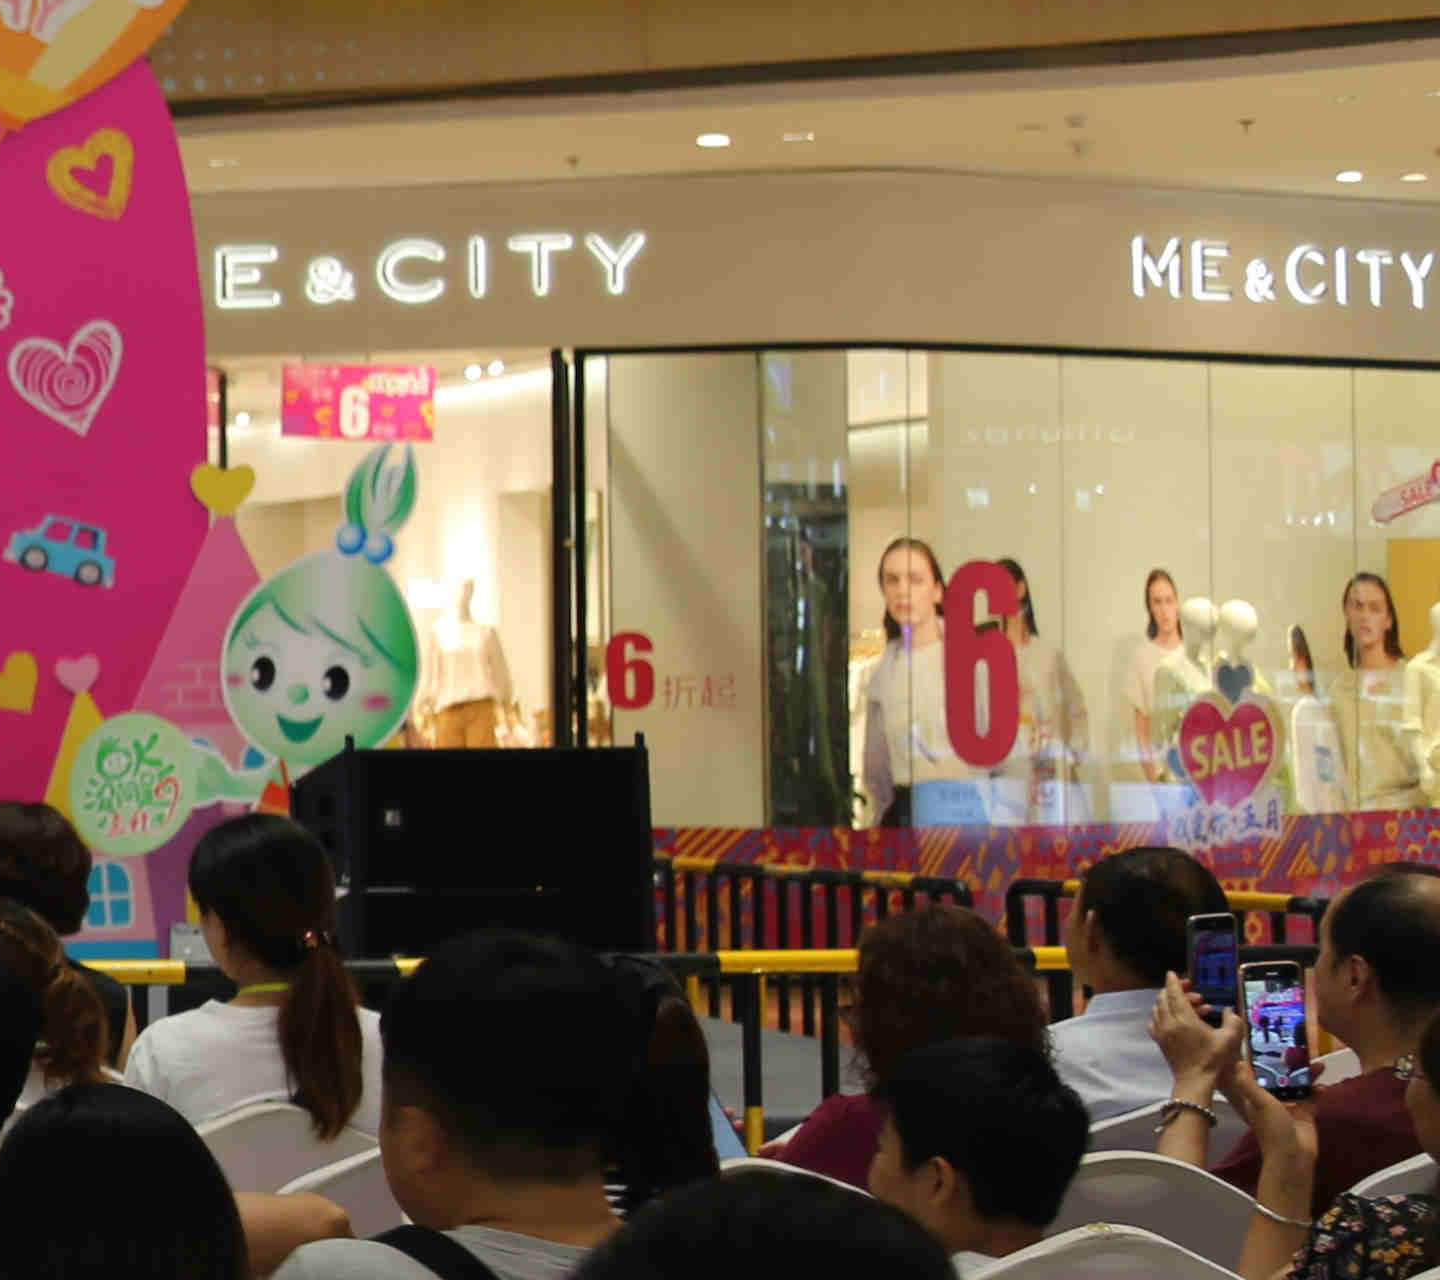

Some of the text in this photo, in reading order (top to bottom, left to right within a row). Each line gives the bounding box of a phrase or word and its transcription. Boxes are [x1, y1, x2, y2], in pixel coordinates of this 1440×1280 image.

[215, 232, 647, 308] E & CITY
[1131, 235, 1435, 310] ME & CITY
[339, 384, 371, 439] 6
[944, 560, 1021, 768] 6
[1190, 721, 1270, 782] SALE
